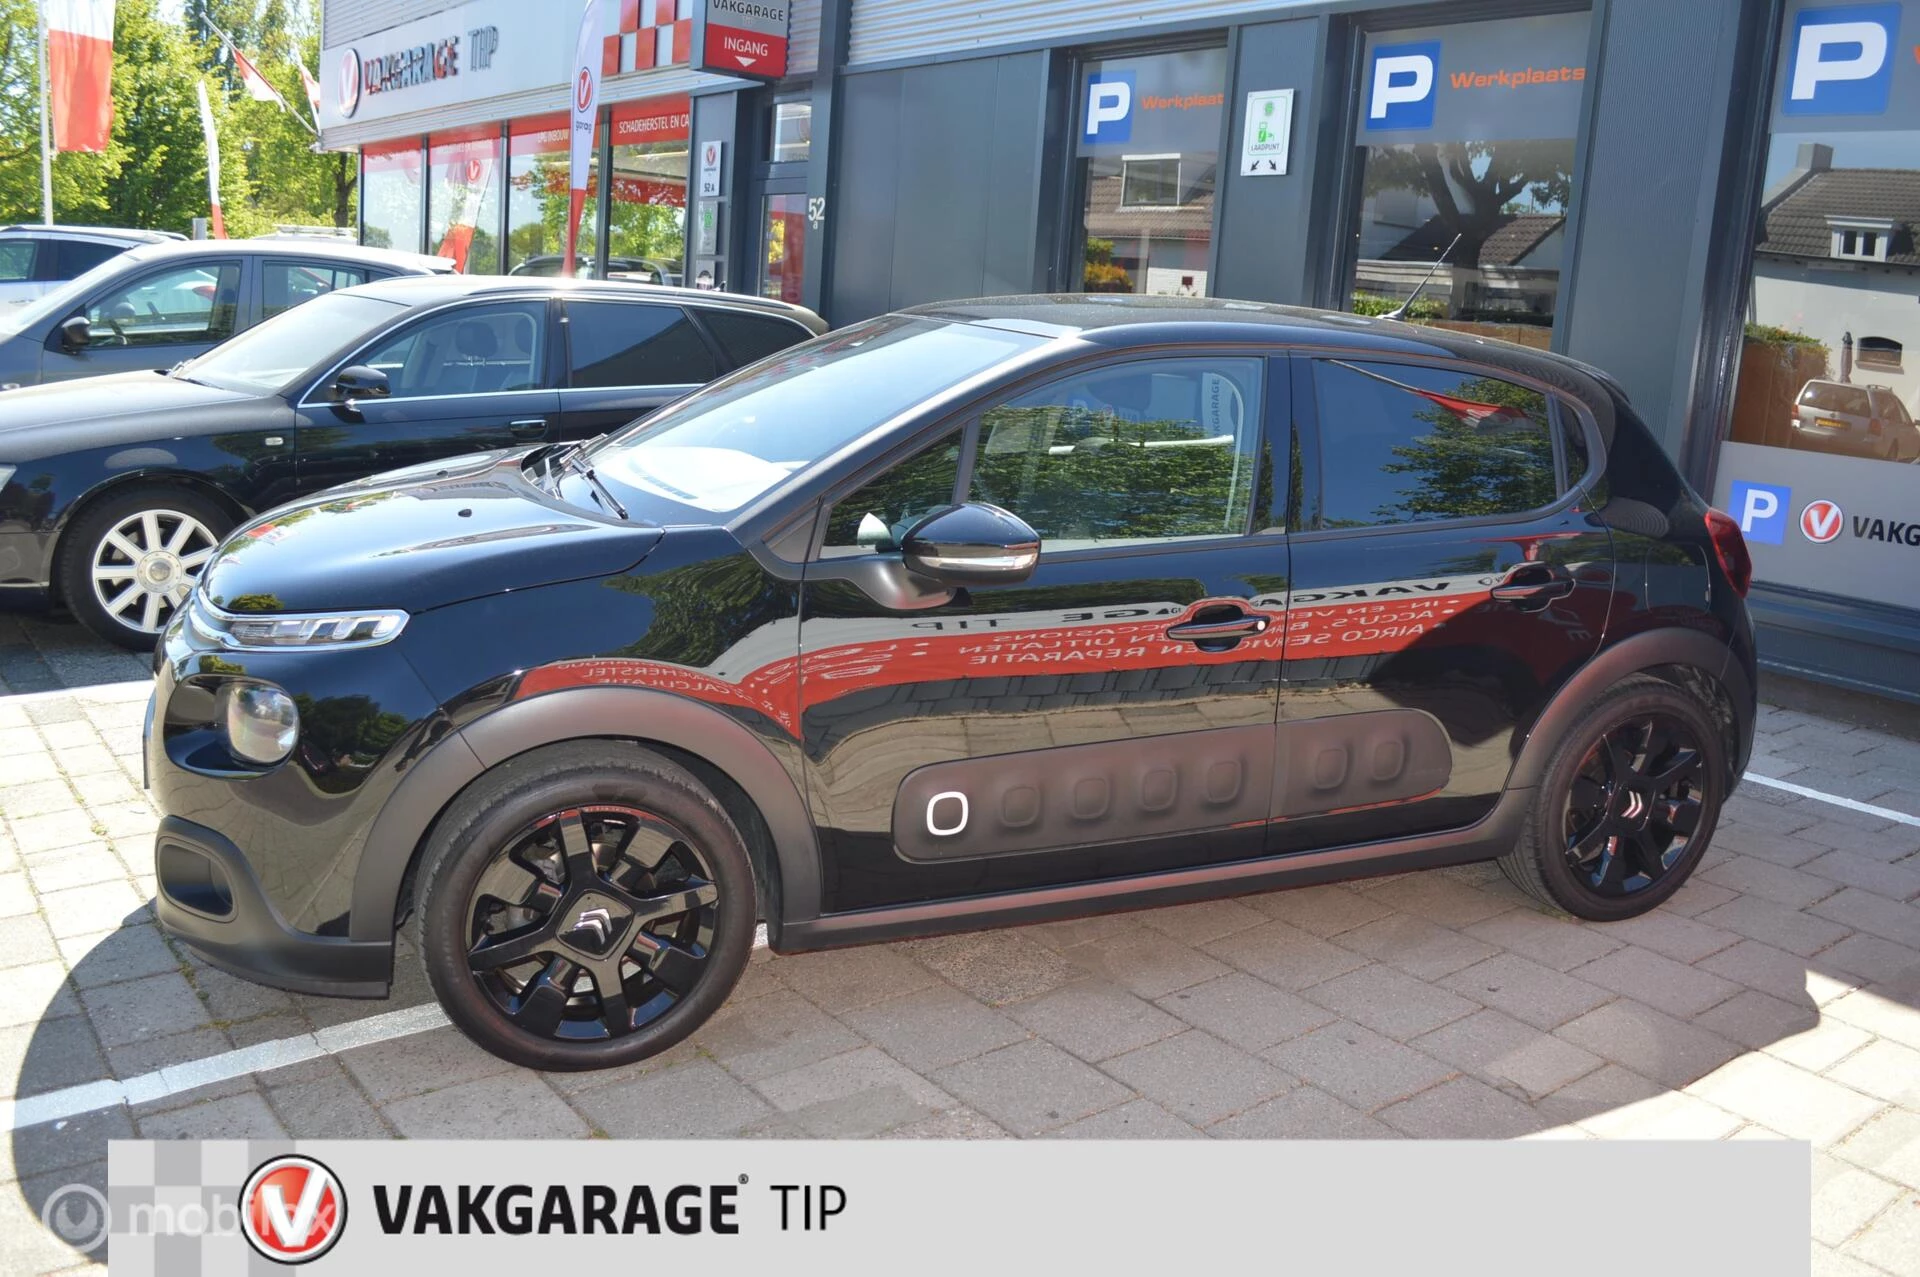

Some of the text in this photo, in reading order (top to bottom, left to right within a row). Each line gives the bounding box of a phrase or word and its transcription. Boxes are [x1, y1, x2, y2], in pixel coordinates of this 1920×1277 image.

[713, 0, 785, 21] VAKGARAGE
[364, 26, 499, 96] VAKGARAGE TIP
[724, 36, 768, 57] INGANG
[1791, 22, 1888, 100] P
[1086, 81, 1131, 135] P
[1370, 54, 1588, 119] P Werkplaats
[619, 116, 669, 134] SCHADEHERSTEL
[670, 115, 680, 128] EN
[808, 197, 825, 221] 52
[1211, 378, 1220, 435] KGARAGE
[1741, 488, 1779, 533] P
